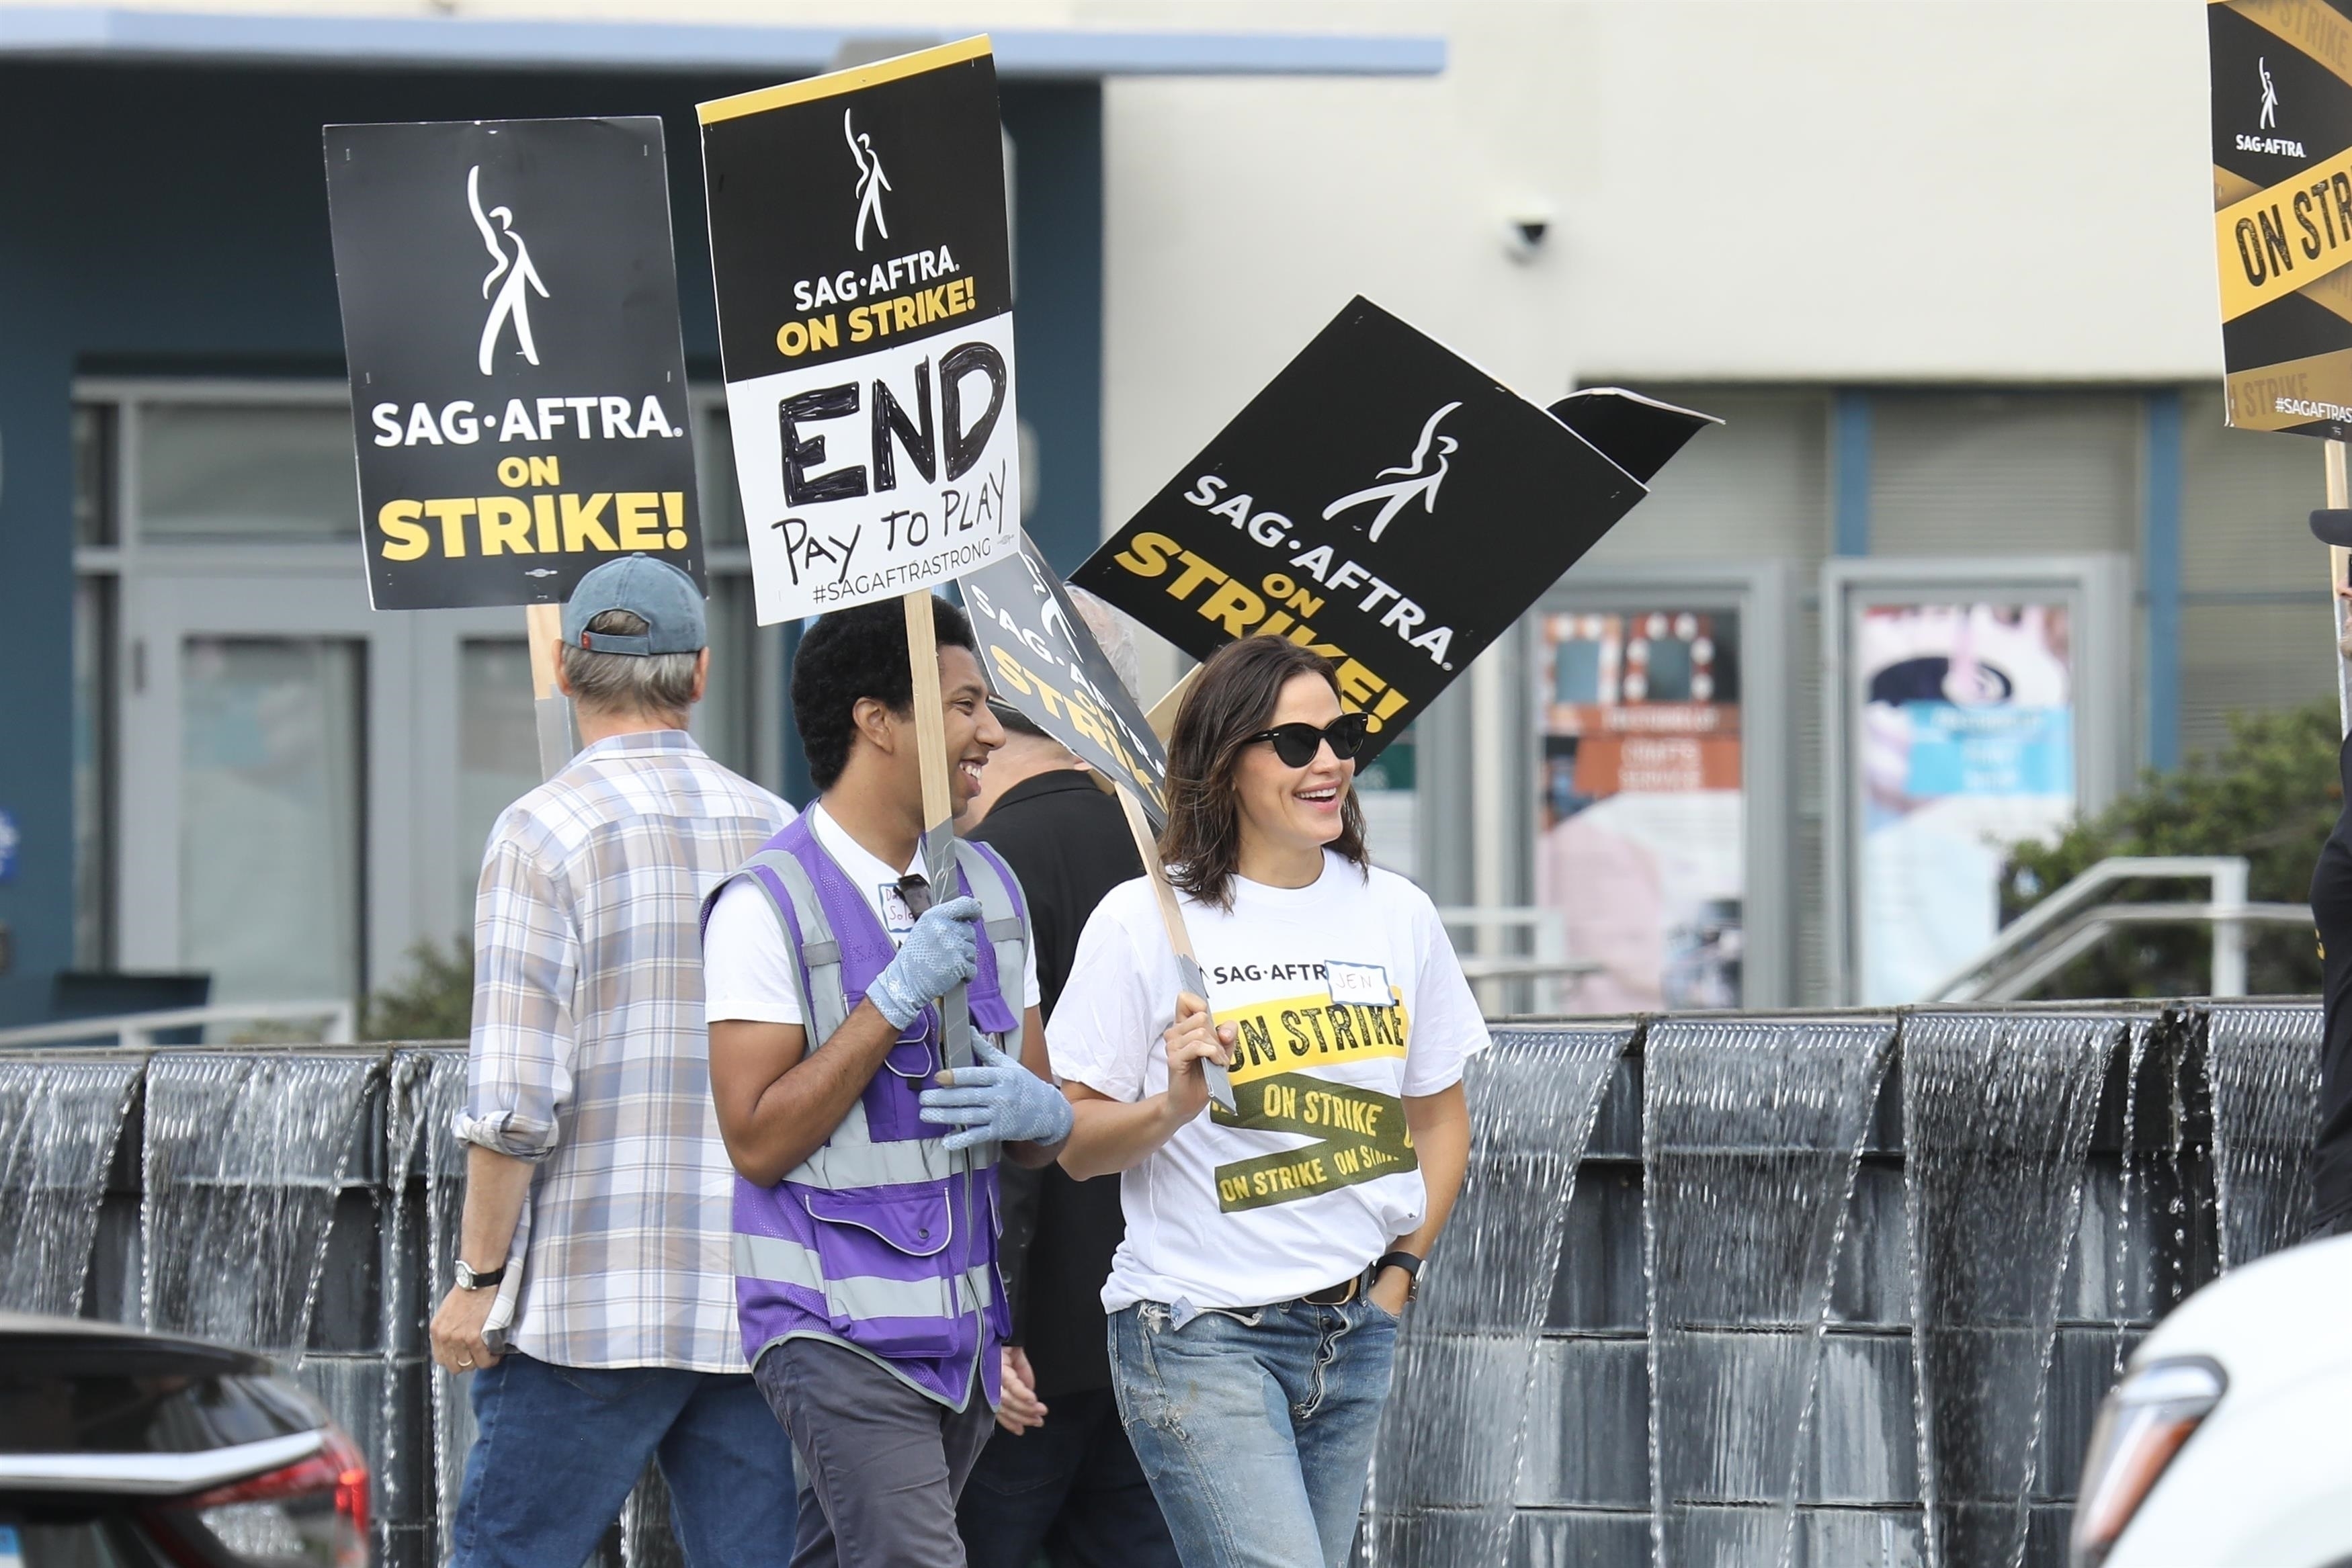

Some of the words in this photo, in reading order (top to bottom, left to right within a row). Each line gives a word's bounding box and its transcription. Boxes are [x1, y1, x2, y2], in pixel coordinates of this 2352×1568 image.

[2235, 203, 2294, 287] ON
[2293, 165, 2352, 260] STR
[777, 314, 838, 357] ON
[849, 275, 976, 343] STRIKE!
[779, 341, 1007, 509] END
[497, 455, 560, 489] ON
[378, 491, 688, 562] STRIKE!
[771, 517, 862, 586] PAY
[881, 509, 929, 553] TO
[941, 458, 1007, 536] PLAY
[812, 536, 992, 605] #SAGAFTRASTRONG
[1261, 572, 1325, 619] ON
[1335, 971, 1372, 990] JEN
[1280, 998, 1404, 1057] STRIKE
[1263, 1083, 1296, 1120] ON
[1303, 1090, 1384, 1137] STRIKE
[1219, 1175, 1251, 1203] ON
[1254, 1158, 1328, 1196] STRIKE
[1333, 1147, 1360, 1176] ON
